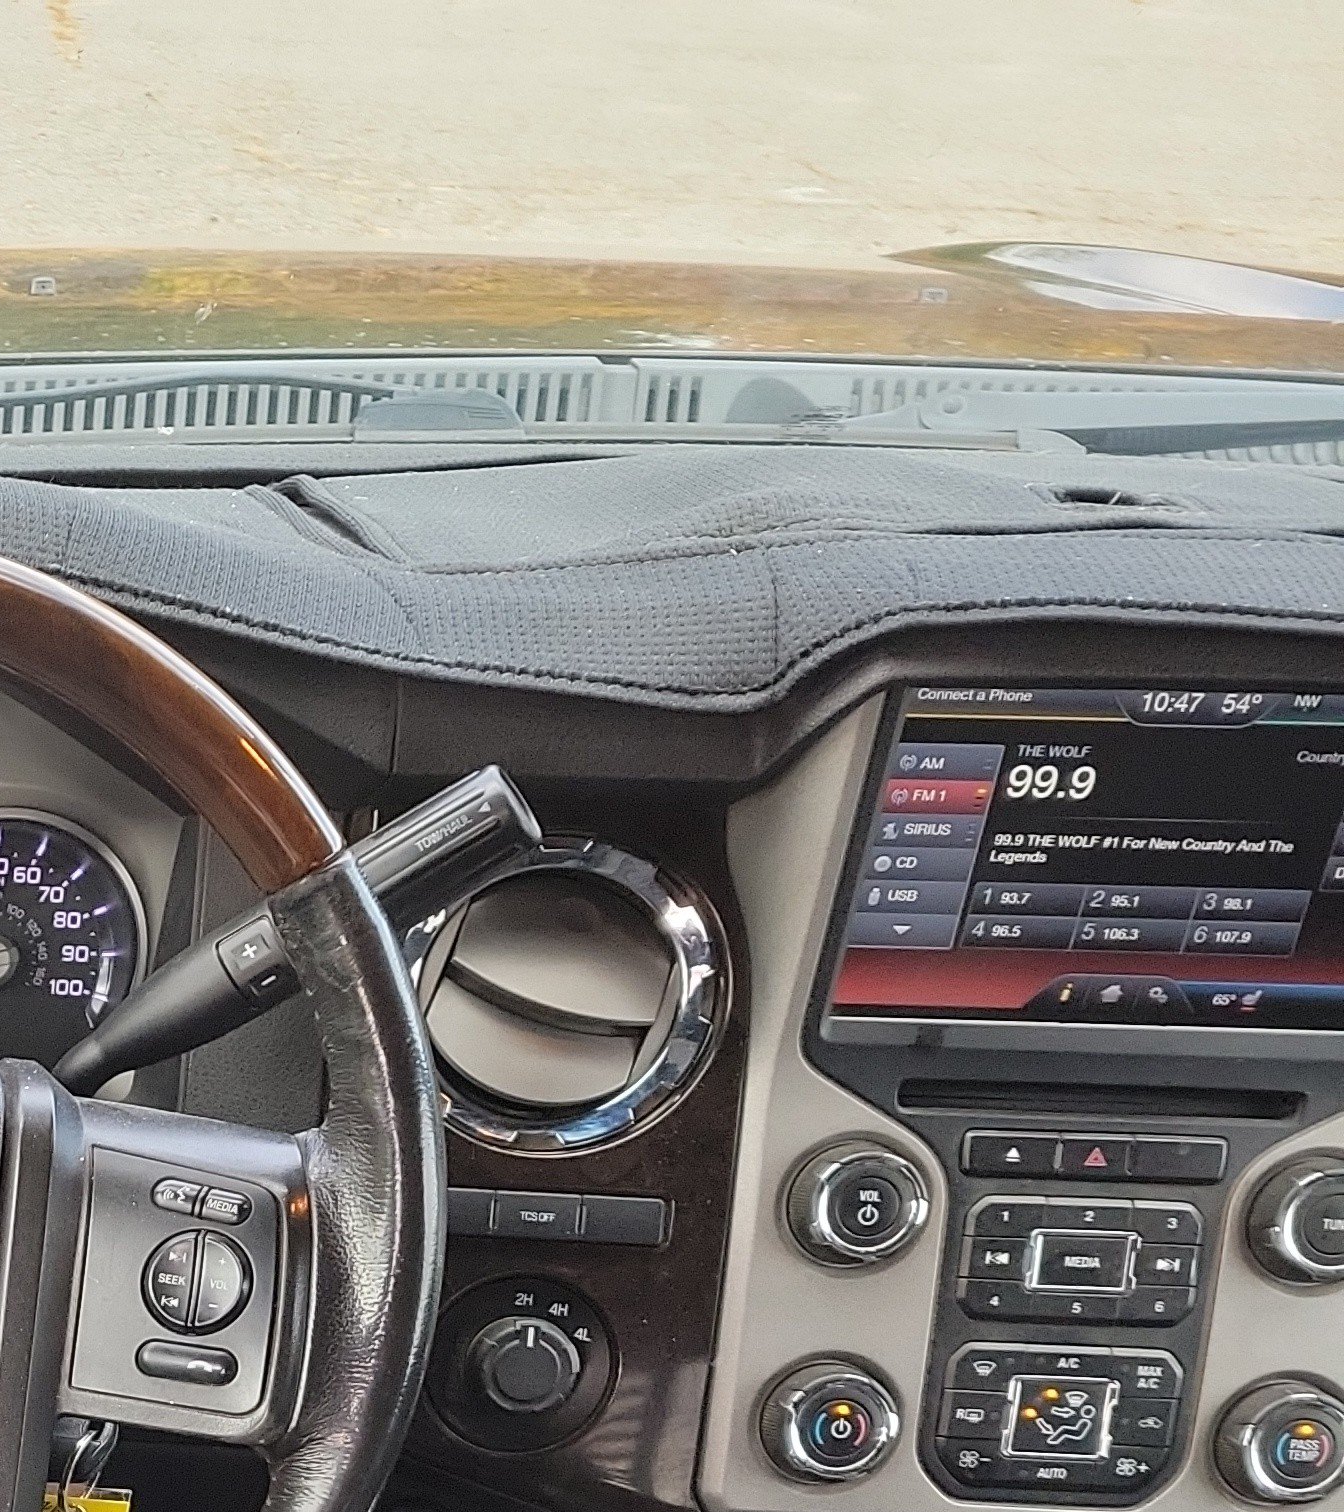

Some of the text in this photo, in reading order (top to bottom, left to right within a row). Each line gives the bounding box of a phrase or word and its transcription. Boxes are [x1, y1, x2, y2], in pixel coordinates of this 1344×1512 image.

[918, 688, 1033, 702] Connect a Phone
[1294, 695, 1322, 707] NW
[1142, 693, 1205, 713] 10:47
[1017, 744, 1093, 758] THE WOLF
[920, 757, 945, 769] AM
[1006, 765, 1096, 799] 99.9
[912, 789, 947, 801] FM 1
[903, 823, 951, 835] SIRIUS
[994, 834, 1294, 854] 99.9 THE WOLF #1 For New Country And The
[895, 857, 918, 869] CD
[990, 850, 1047, 865] Legends
[13, 867, 41, 884] 60
[38, 886, 65, 903] 70
[888, 889, 918, 901] USB
[983, 888, 1031, 905] 1 93.7
[1090, 891, 1140, 908] 2 95.1
[1203, 893, 1217, 910] 3
[53, 911, 81, 928] 80
[972, 921, 1021, 938] 4 96.5
[1081, 923, 1139, 941] 5 106.3
[1194, 926, 1252, 944] 6 107.9
[61, 945, 89, 962] 90
[49, 979, 84, 996] 100
[859, 1189, 882, 1204] VOL
[206, 1198, 239, 1214] MEDIA
[519, 1210, 556, 1223] TCS OFF
[1001, 1211, 1010, 1222] 1
[1083, 1211, 1095, 1222] 2
[1167, 1217, 1179, 1229] 3
[1064, 1256, 1101, 1268] MEDIA
[158, 1273, 186, 1286] SEEK
[514, 1293, 533, 1306] 2H
[989, 1296, 1000, 1307] 4
[548, 1303, 569, 1317] 4H
[1071, 1302, 1082, 1314] 5
[1154, 1301, 1165, 1313] 6
[573, 1328, 591, 1342] 4L
[1057, 1357, 1080, 1368] A/C
[1137, 1366, 1163, 1377] MAX
[1289, 1438, 1320, 1451] PASS
[1288, 1450, 1320, 1461] TEMP
[1037, 1468, 1068, 1480] AUTO
